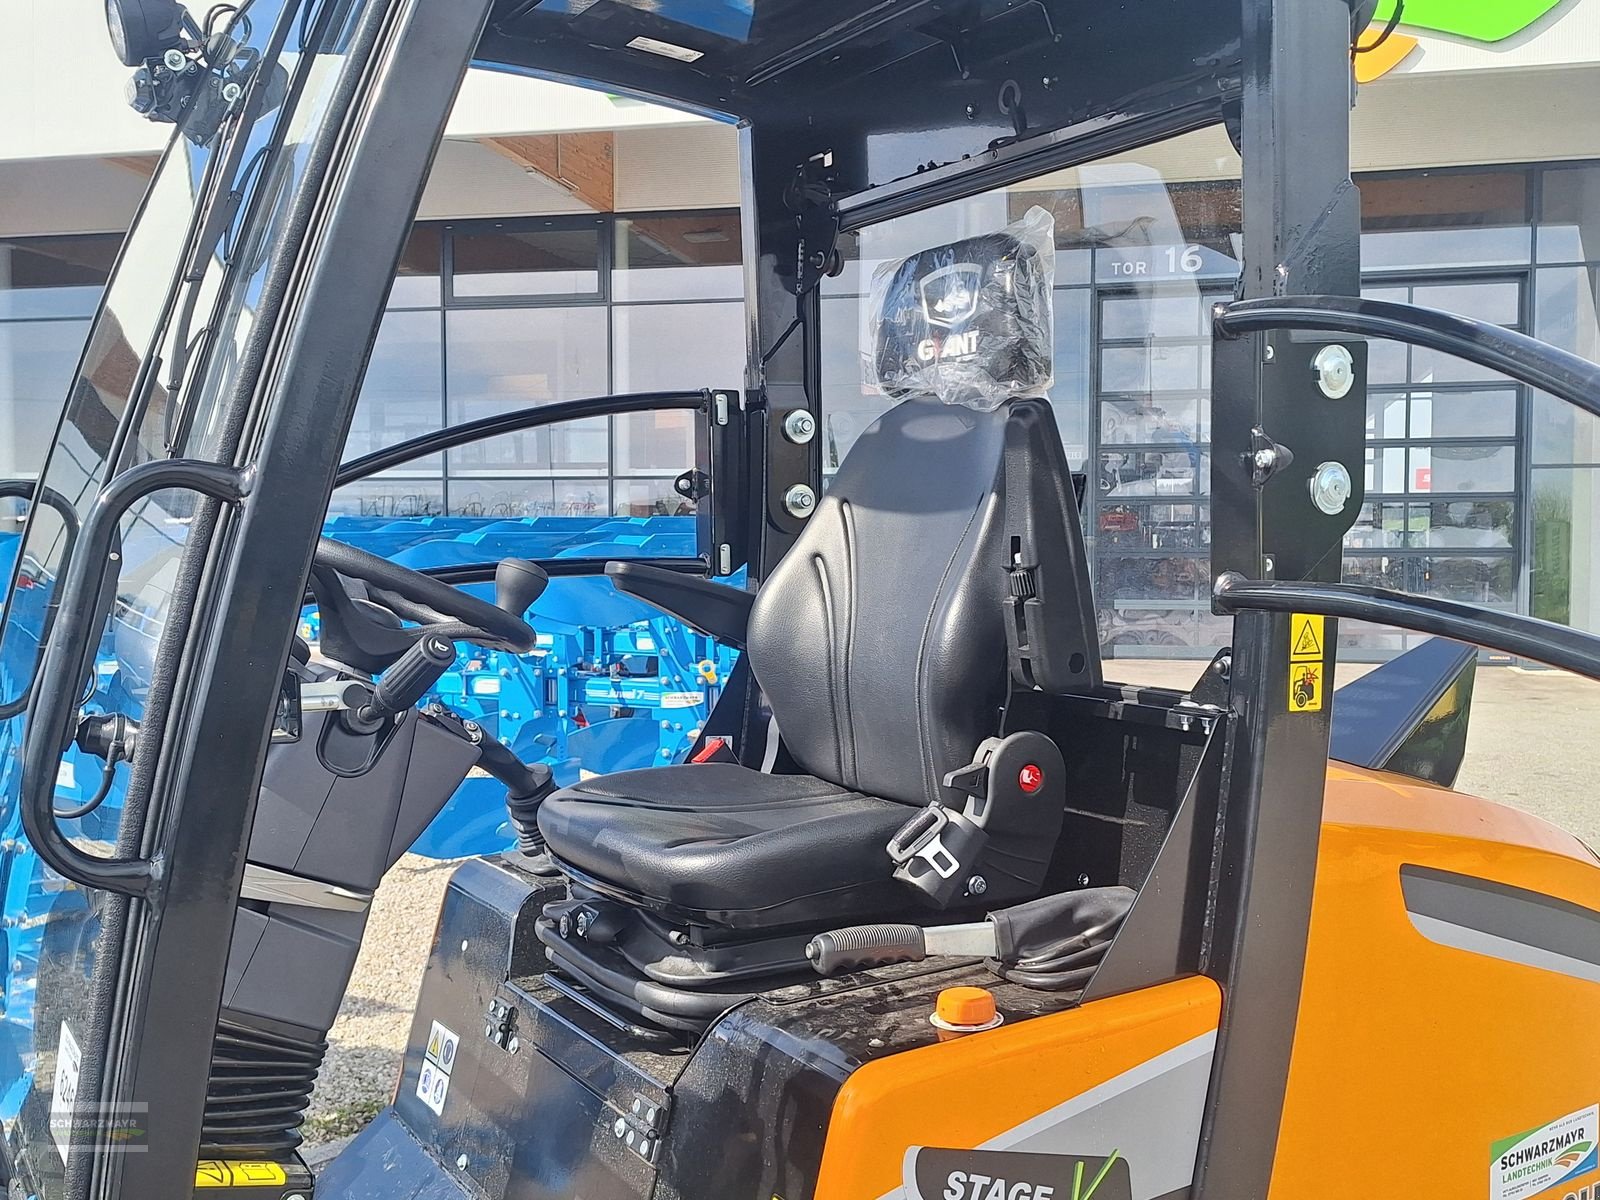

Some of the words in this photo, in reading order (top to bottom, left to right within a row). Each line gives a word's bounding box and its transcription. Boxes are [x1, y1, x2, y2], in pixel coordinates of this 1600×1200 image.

[1112, 261, 1147, 275] TOR
[1165, 245, 1203, 273] 16
[1500, 1127, 1585, 1171] SCHWARZMAYR
[1502, 1157, 1553, 1184] LANDTECHNIK
